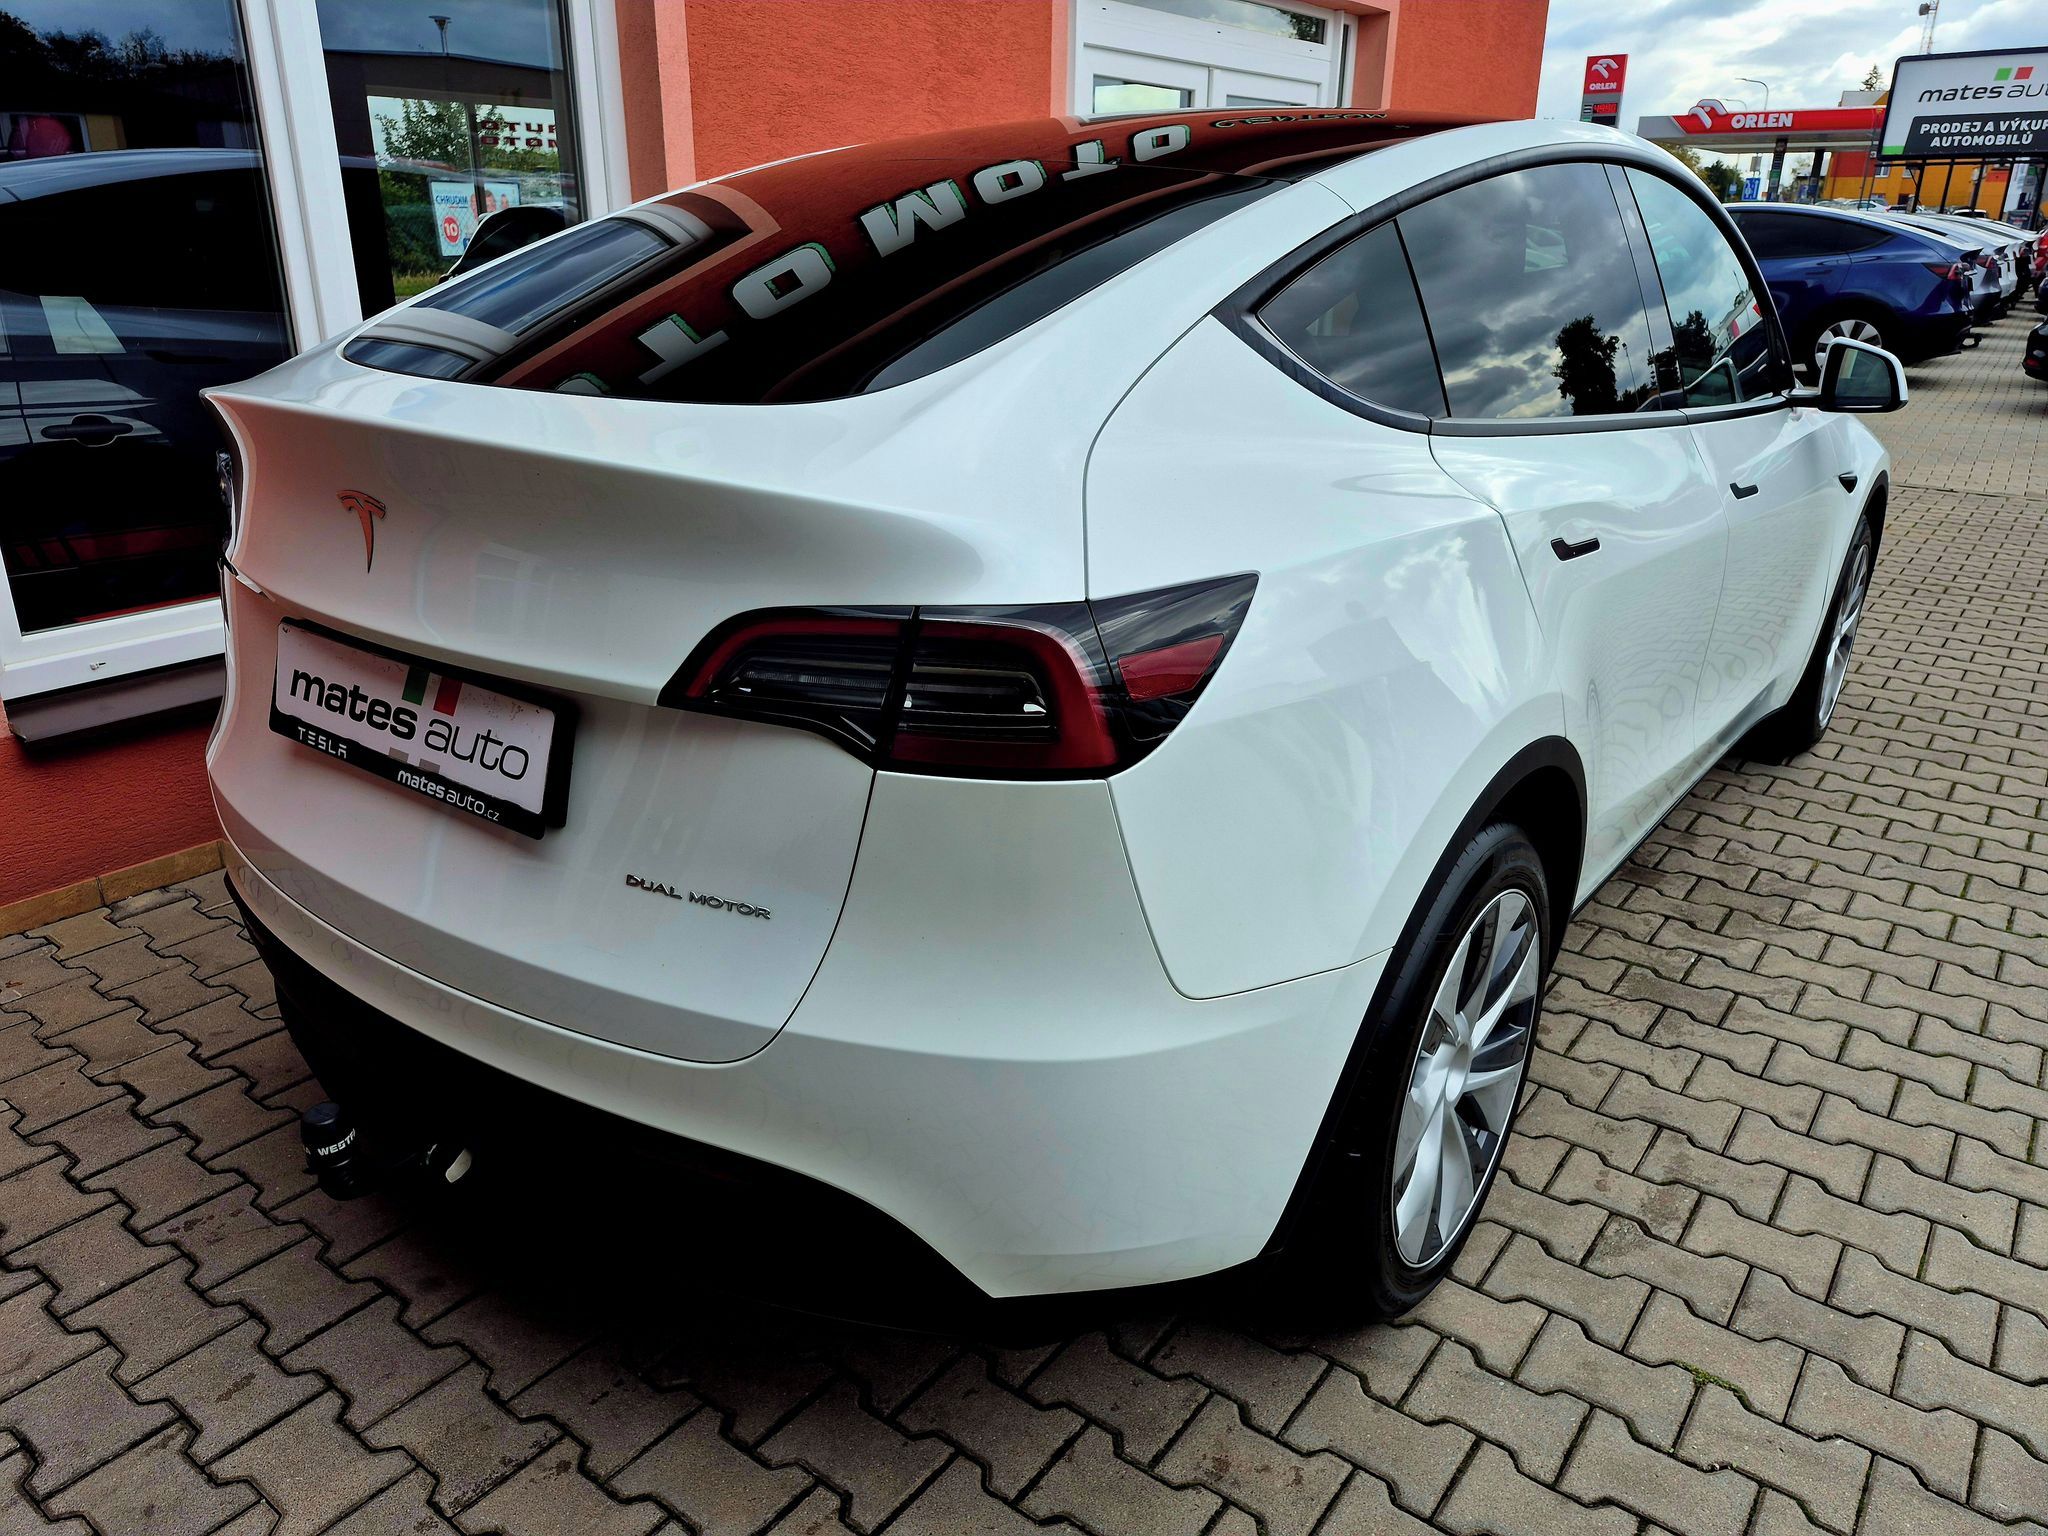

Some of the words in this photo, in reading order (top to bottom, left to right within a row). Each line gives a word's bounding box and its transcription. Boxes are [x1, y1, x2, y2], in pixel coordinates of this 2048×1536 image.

[1589, 82, 1617, 91] ORLEN
[1919, 84, 2005, 103] mates
[2007, 83, 2048, 99] au
[1731, 112, 1794, 129] ORLEN
[1919, 121, 1983, 135] PRODEJ
[1983, 120, 1995, 133] A
[1930, 131, 2033, 148] AUTOMOBILŮ
[435, 195, 469, 205] CHRUDIM
[444, 223, 458, 237] 10
[290, 668, 418, 741] mates
[424, 716, 529, 781] auto
[297, 726, 347, 759] TESLA
[625, 873, 683, 900] DUAL
[688, 890, 771, 920] MOTOR
